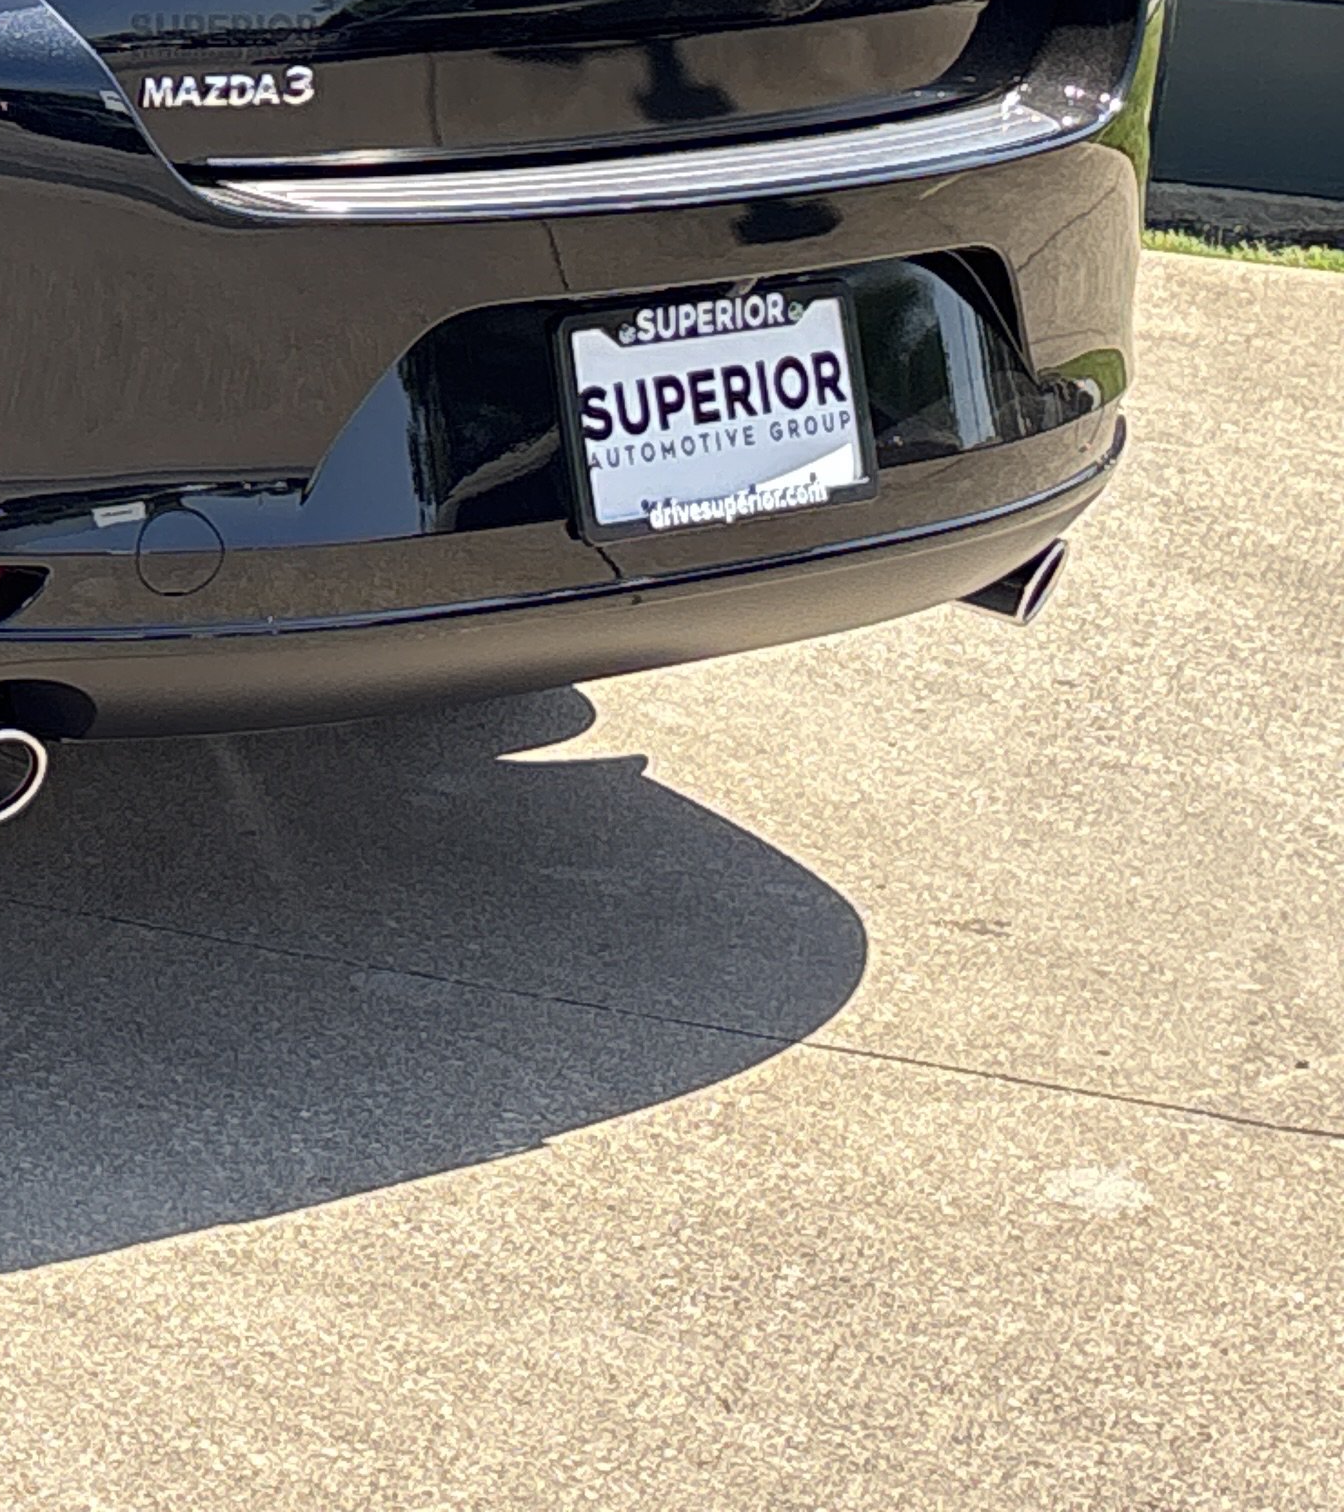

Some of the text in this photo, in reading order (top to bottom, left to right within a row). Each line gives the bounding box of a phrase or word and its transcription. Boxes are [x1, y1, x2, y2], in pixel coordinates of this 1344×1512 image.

[141, 65, 315, 108] MAZDA3
[635, 292, 785, 341] SUPERIOR
[579, 350, 847, 442] SUPERIOR
[588, 411, 852, 470] AUTOMOTIVE GROUP
[648, 482, 829, 530] drivesuperior.com
